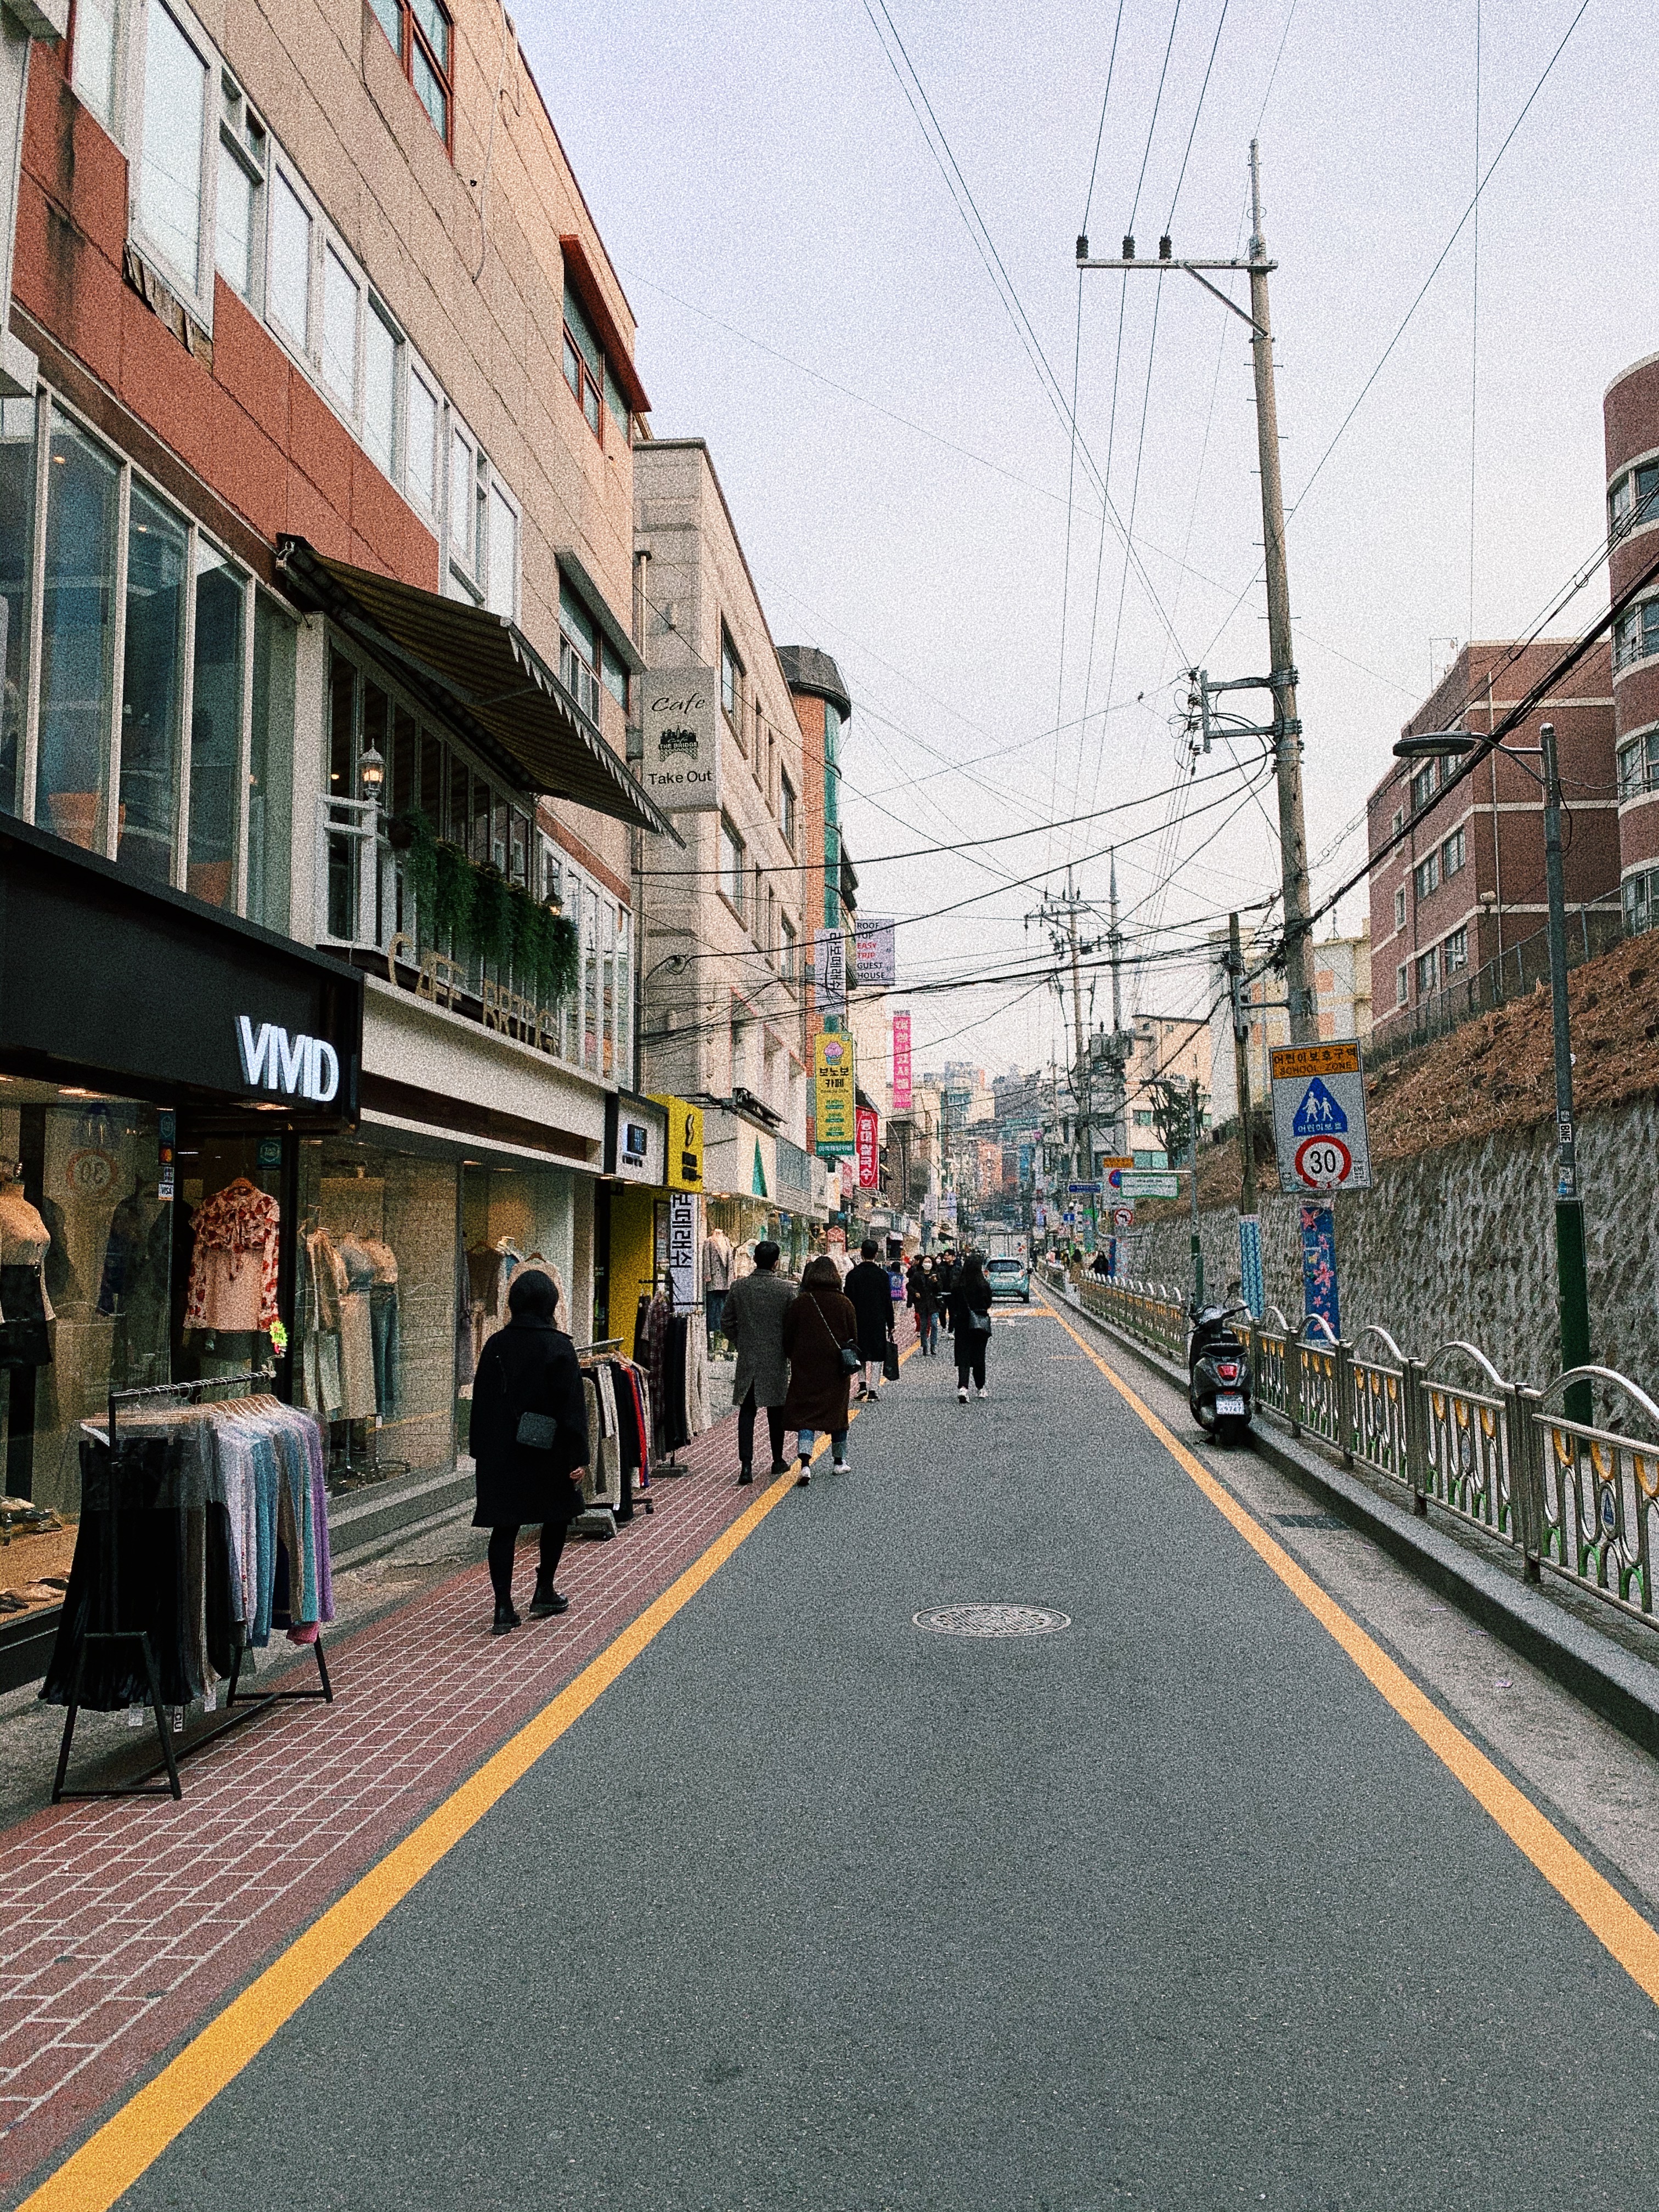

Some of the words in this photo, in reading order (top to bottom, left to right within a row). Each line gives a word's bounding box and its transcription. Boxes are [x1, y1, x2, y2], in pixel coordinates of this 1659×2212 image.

[652, 693, 705, 714] Cafe
[648, 772, 683, 785] Take
[687, 770, 712, 782] Out
[237, 1015, 339, 1101] VIVID
[1274, 1047, 1356, 1064] 어린이보호구역
[820, 1067, 849, 1076] 보노보
[1280, 1065, 1318, 1075] SCHOOL
[1325, 1062, 1352, 1070] ZONE
[825, 1079, 844, 1088] 카페
[1298, 1122, 1342, 1133] 어린이보호
[1310, 1149, 1336, 1174] 30
[161, 1187, 172, 1195] VISA
